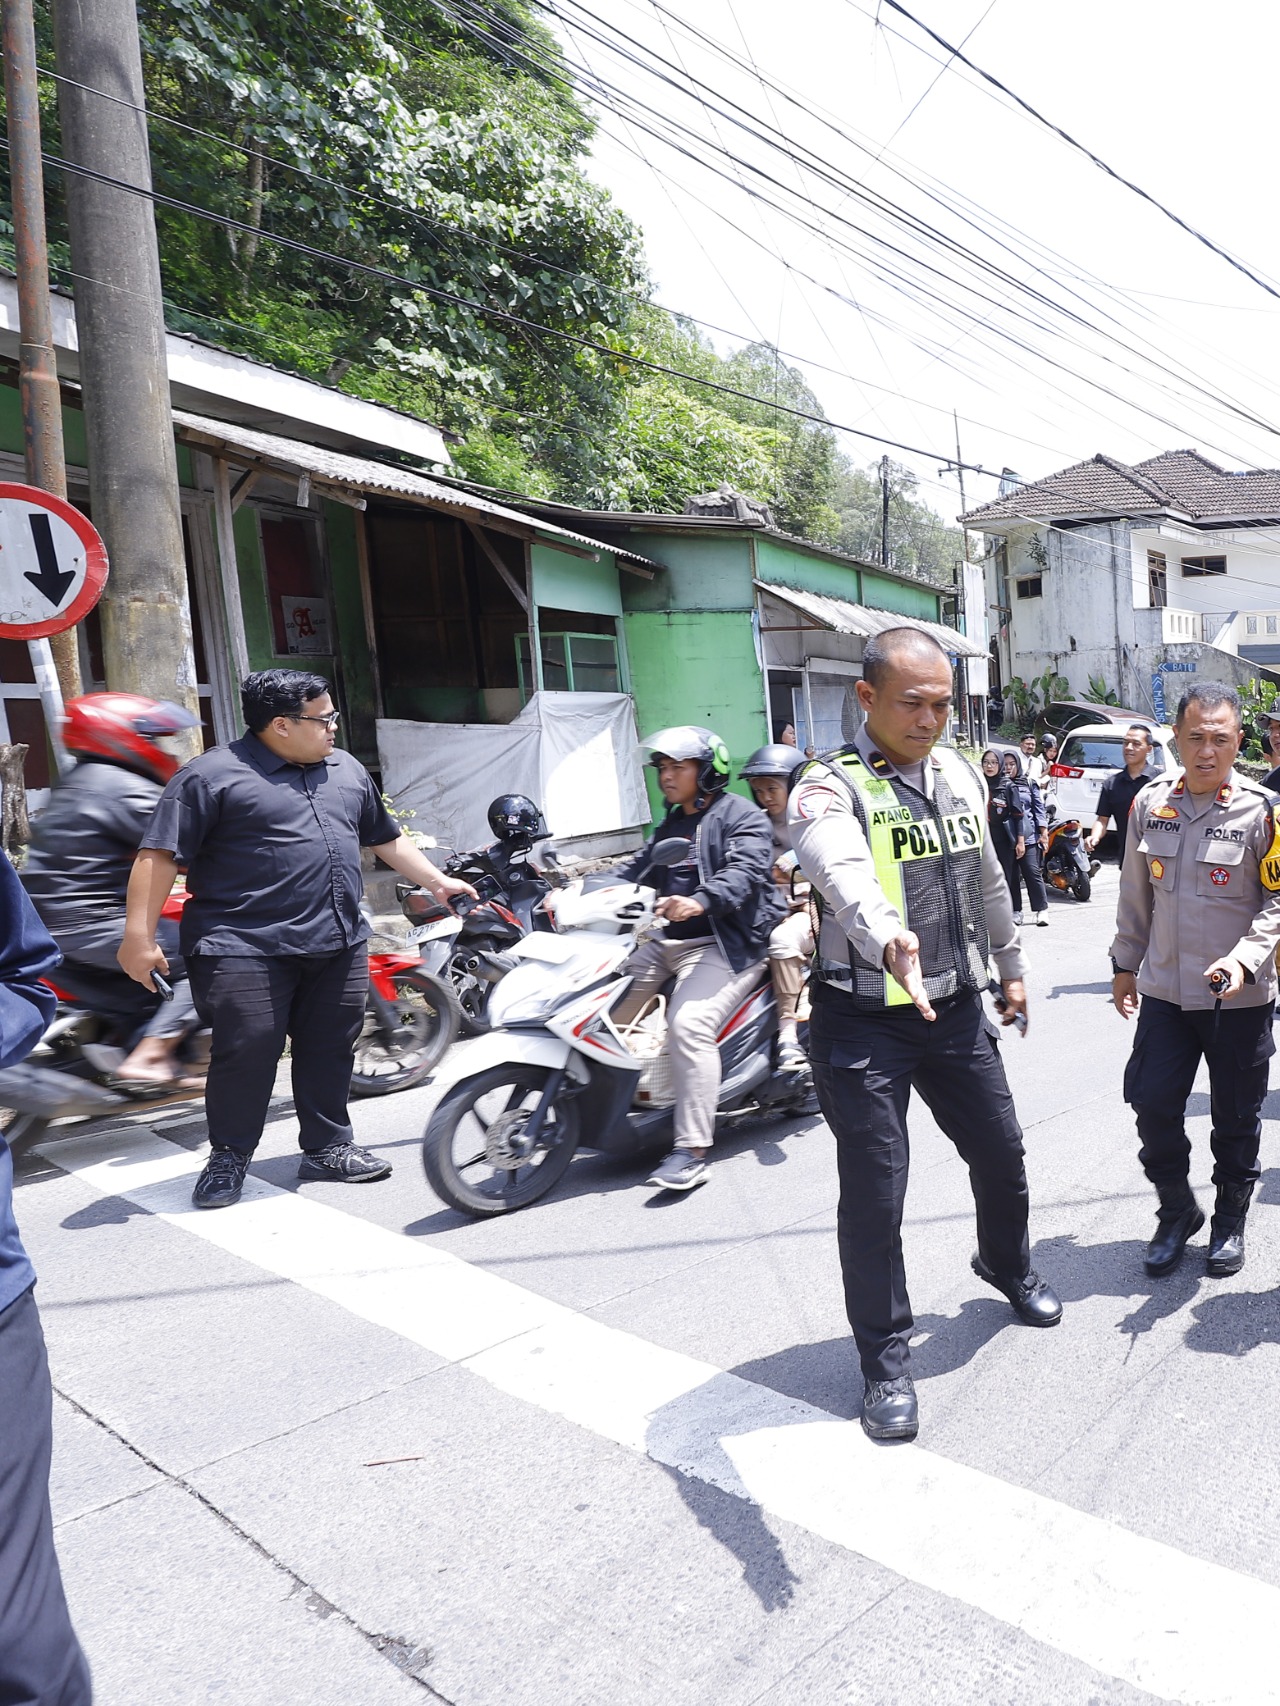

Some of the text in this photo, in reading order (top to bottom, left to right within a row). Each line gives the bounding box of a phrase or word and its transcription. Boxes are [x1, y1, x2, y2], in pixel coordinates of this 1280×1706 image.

[1172, 663, 1193, 672] BATU
[1153, 690, 1165, 723] MALANG
[873, 808, 910, 826] ATANG
[1146, 820, 1181, 833] ANTON
[891, 815, 982, 860] POLISI
[1204, 828, 1245, 841] POLRI
